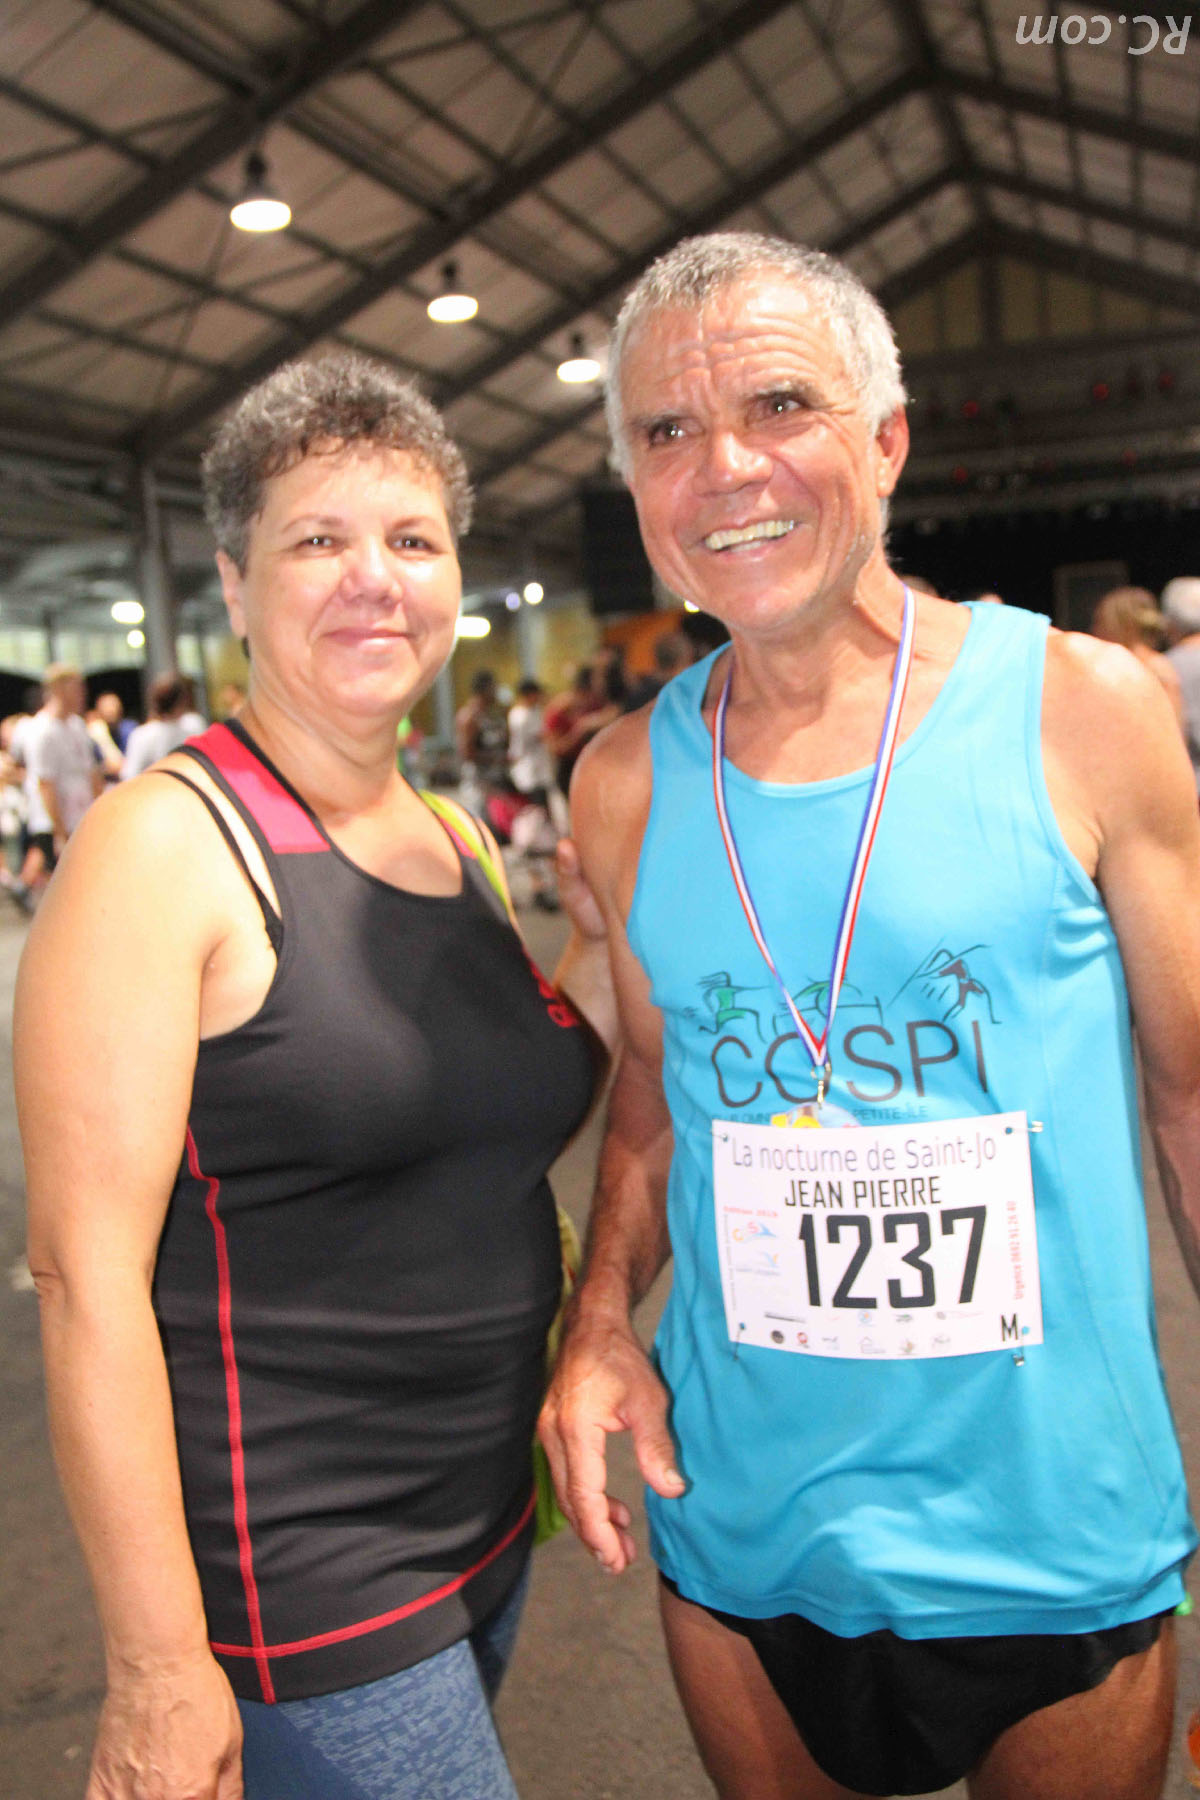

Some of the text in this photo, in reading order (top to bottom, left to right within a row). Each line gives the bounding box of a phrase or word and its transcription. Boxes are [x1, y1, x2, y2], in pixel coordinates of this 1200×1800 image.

[732, 1132, 996, 1172] La nocturne de Saint-Jo
[785, 1176, 941, 1208] JEAN PIERRE
[799, 1205, 987, 1310] 1237
[1000, 1313, 1018, 1341] M
